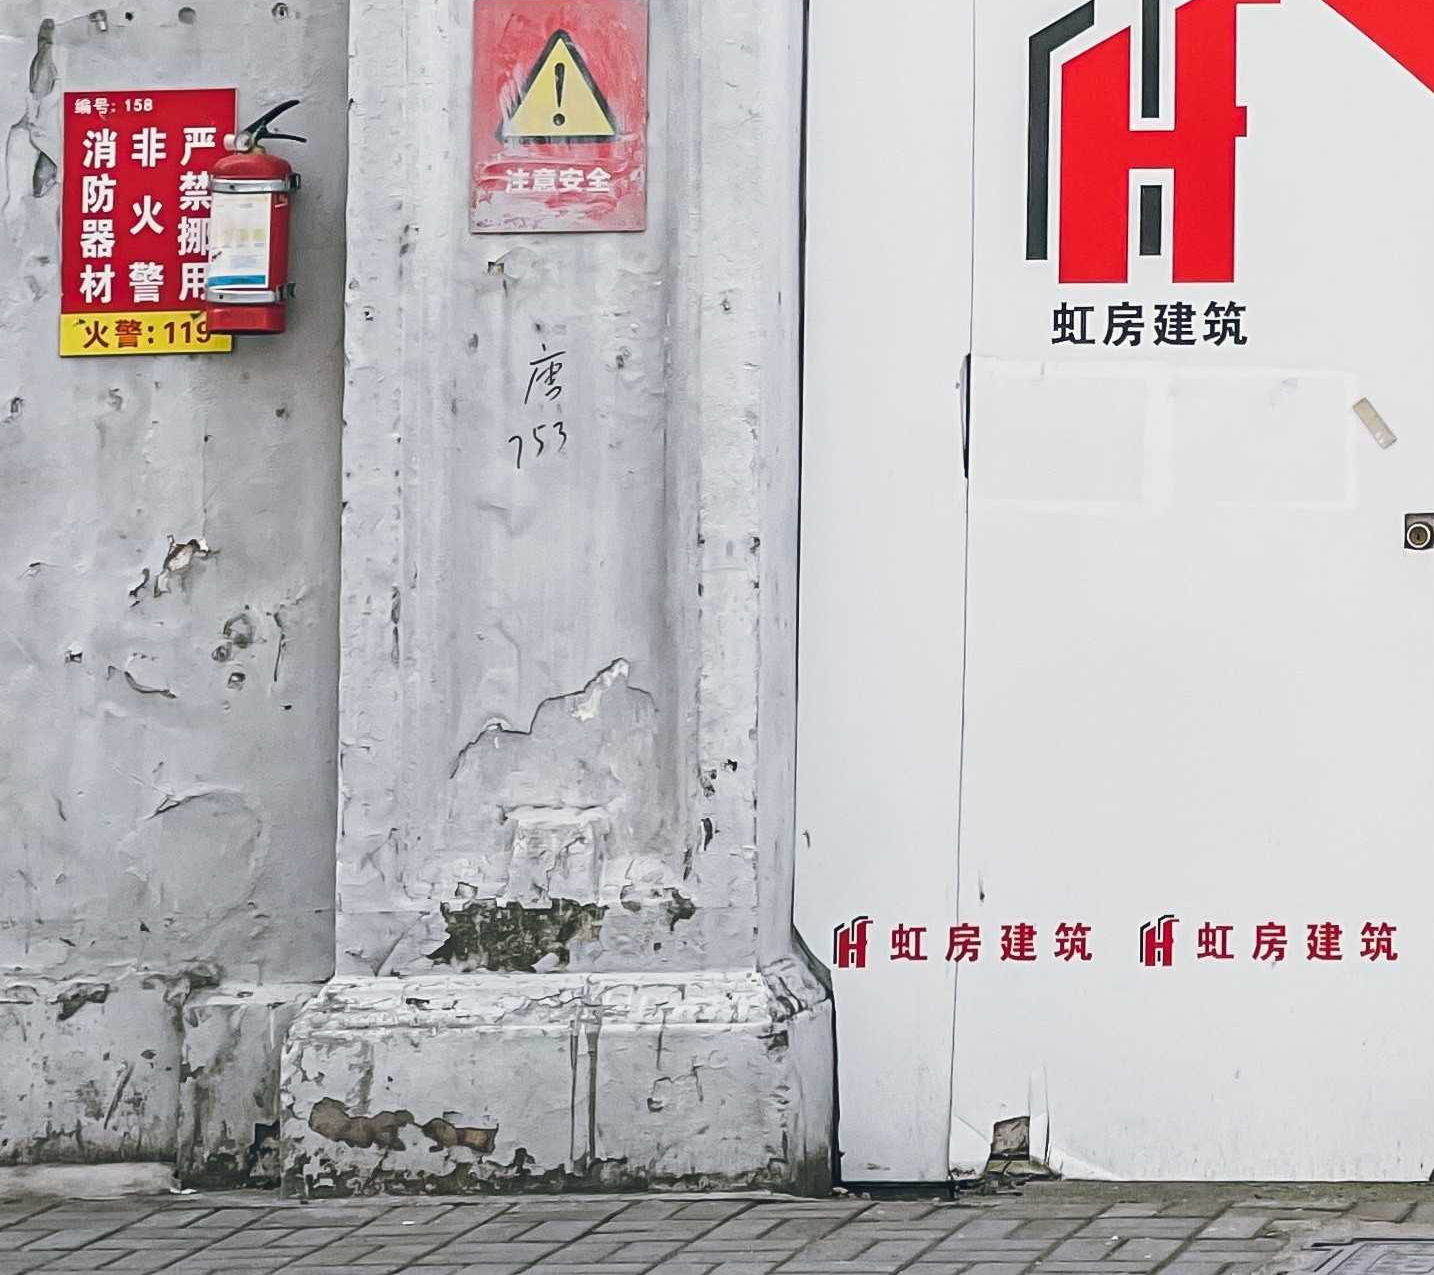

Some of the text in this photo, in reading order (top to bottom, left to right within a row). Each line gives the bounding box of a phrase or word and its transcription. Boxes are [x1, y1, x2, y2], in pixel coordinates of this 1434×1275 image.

[505, 167, 612, 194] 注意安全
[79, 127, 118, 304] 消防器材
[128, 126, 167, 303] 非火警
[176, 126, 217, 302] 严禁挪用
[1051, 300, 1248, 347] 虹房建筑
[890, 922, 1093, 962] 虹房建筑
[1197, 922, 1399, 962] 虹房建筑
